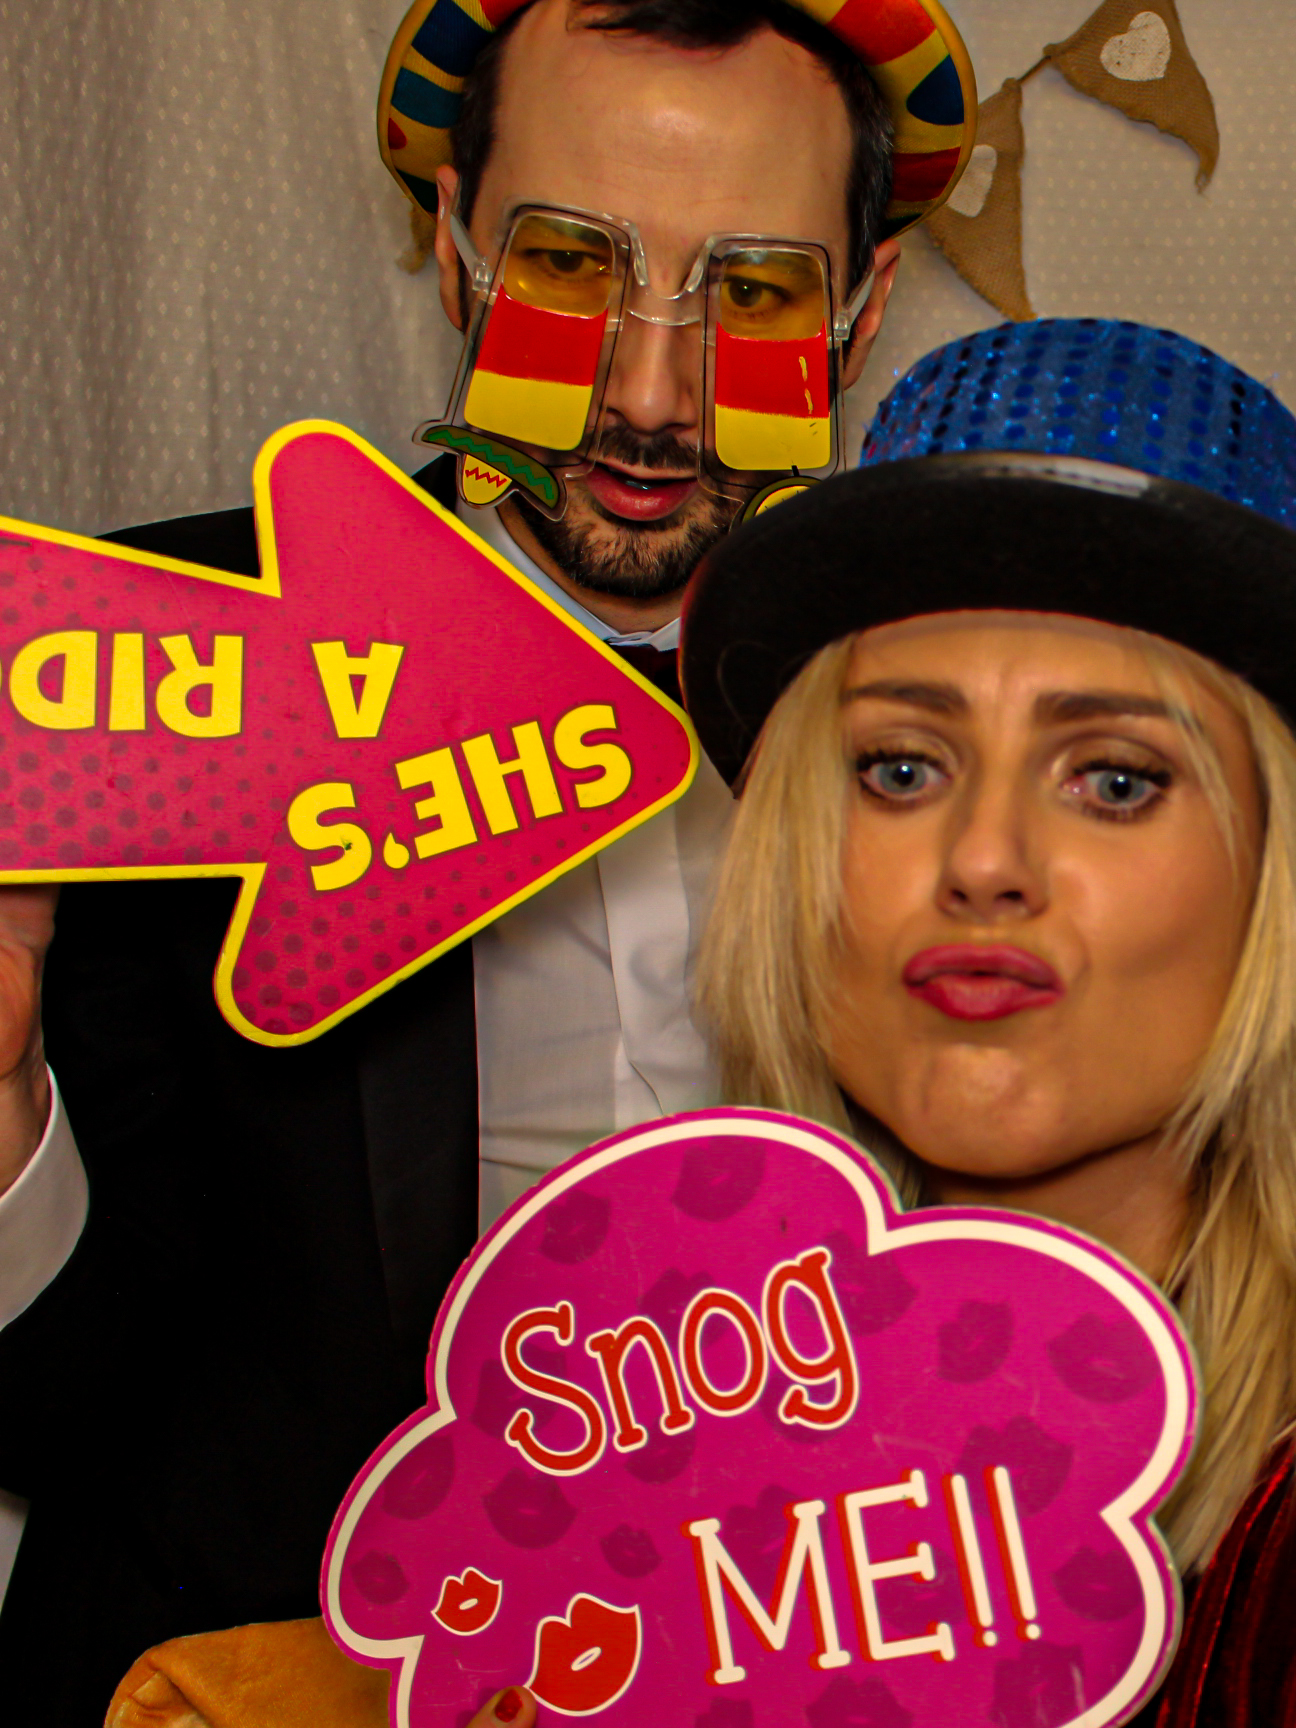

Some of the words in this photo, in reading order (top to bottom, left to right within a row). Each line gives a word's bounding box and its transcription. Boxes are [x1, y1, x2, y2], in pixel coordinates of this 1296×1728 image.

[0, 630, 244, 739] RID
[311, 640, 405, 739] A
[287, 704, 632, 892] SHE'S
[501, 1246, 859, 1476] Snog
[678, 1464, 1041, 1687] ME!!
